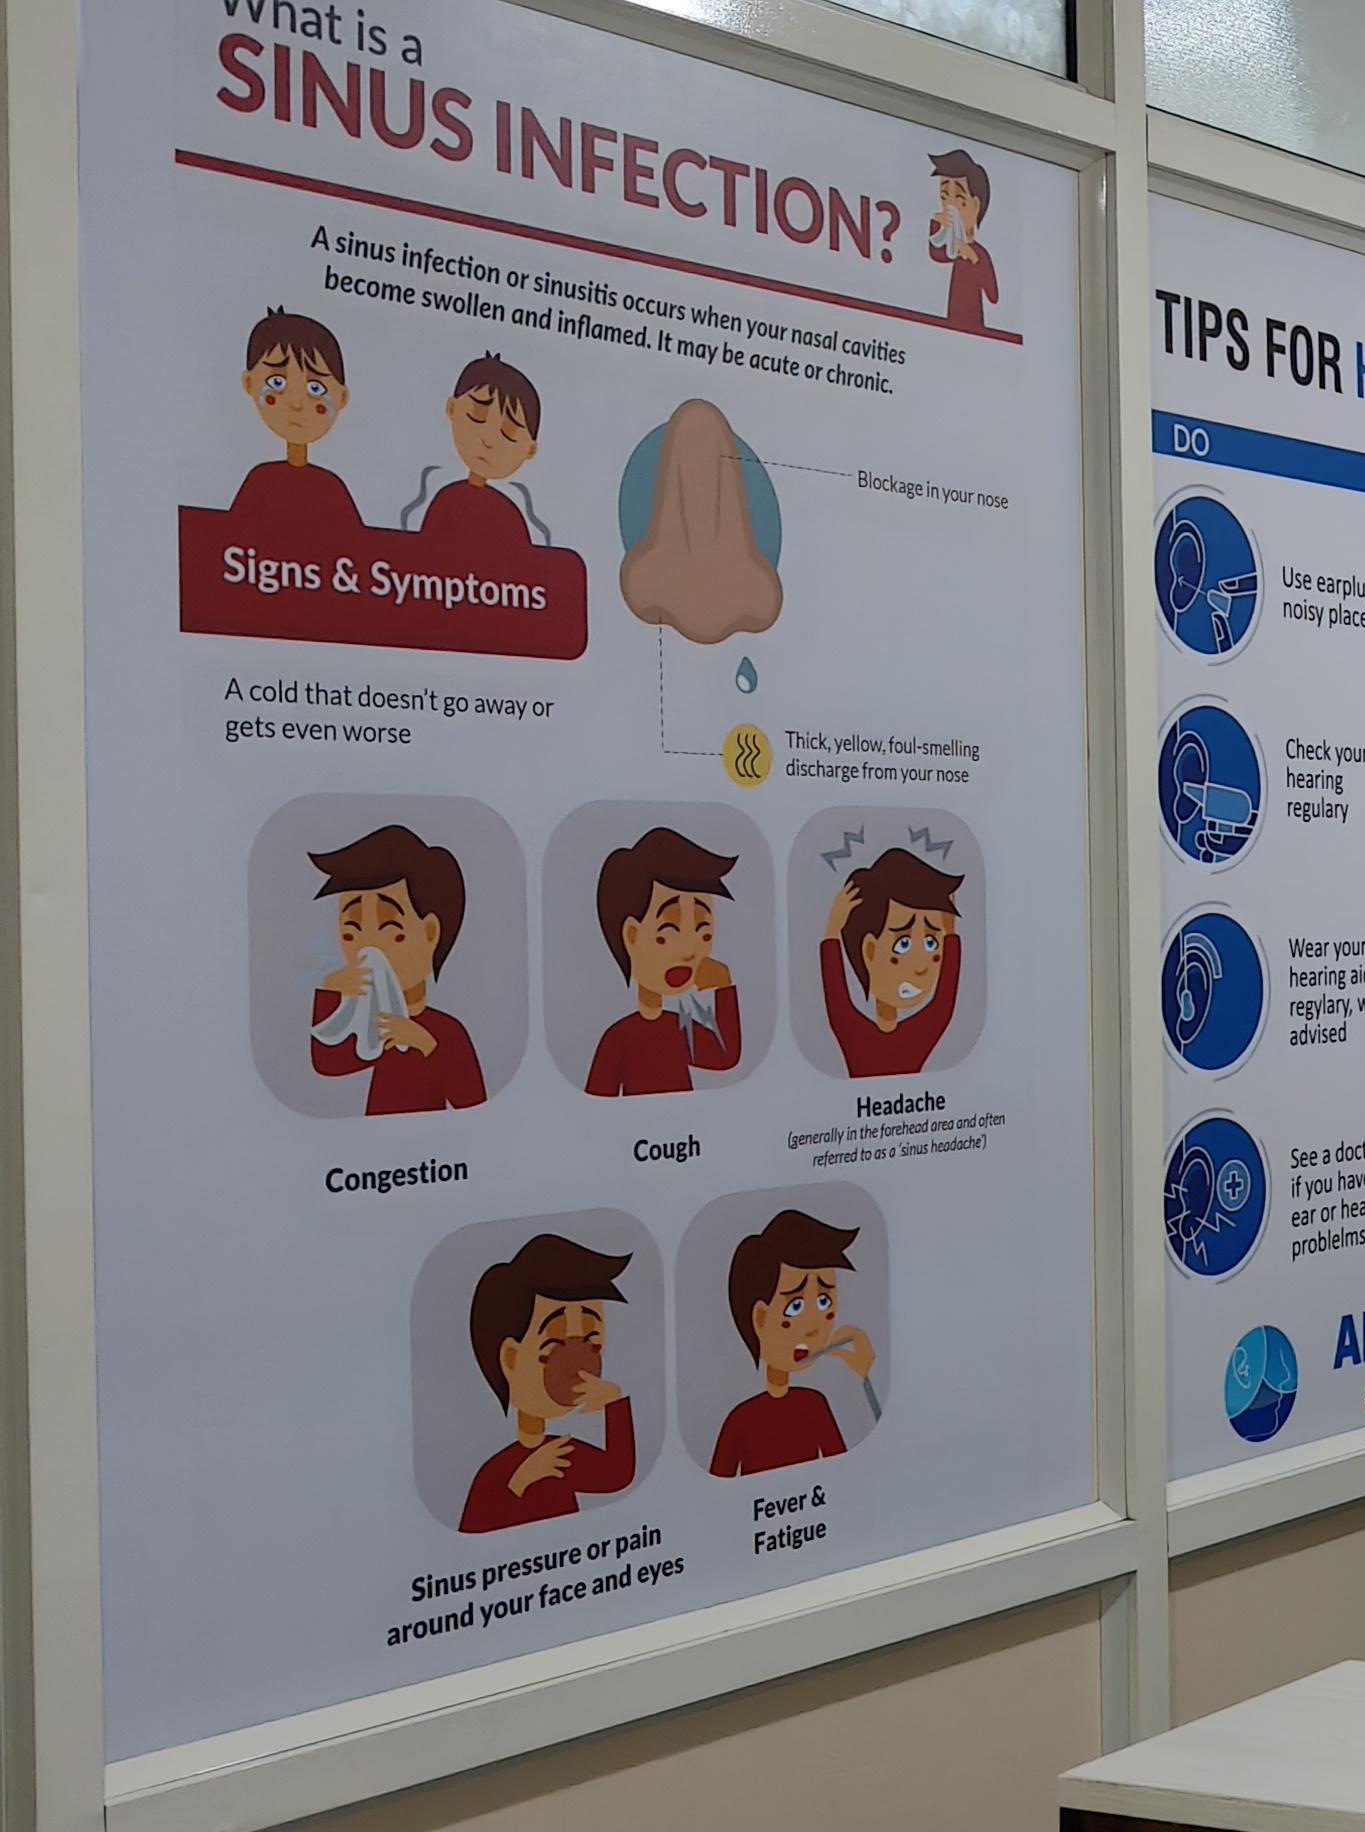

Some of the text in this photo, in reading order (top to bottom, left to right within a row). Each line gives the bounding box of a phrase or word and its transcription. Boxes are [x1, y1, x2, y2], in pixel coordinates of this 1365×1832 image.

[356, 8, 388, 56] is
[401, 34, 423, 67] a
[215, 32, 902, 264] SINUS INFECTION?
[310, 225, 906, 365] A sinus infection or sinusitis occurs when your nasal cavities
[324, 264, 893, 395] become swollen and inflamed. It may be acute or chronic.
[1155, 288, 1250, 372] TIPS
[1265, 317, 1344, 395] FOR
[1173, 423, 1210, 457] DO
[857, 469, 1009, 510] Blockage in your nose
[223, 545, 547, 610] Signs & Symptoms
[1282, 565, 1312, 591] Use
[1283, 598, 1325, 628] noisy
[224, 677, 244, 702] A
[249, 679, 298, 704] cold
[304, 681, 353, 707] that
[443, 696, 469, 718] go
[474, 697, 528, 721] away
[532, 700, 555, 718] or
[225, 716, 411, 745] gets even worse
[784, 730, 980, 762] Thick, yellow, foul-smelling
[1285, 737, 1332, 761] Check
[785, 757, 970, 785] discharge from your nose
[1286, 765, 1344, 796] hearing
[1287, 796, 1349, 824] regulary
[1288, 937, 1330, 959] Wear
[1289, 965, 1347, 991] hearing
[1289, 992, 1353, 1021] regylary,
[1289, 1020, 1347, 1047] advised
[856, 1090, 946, 1119] Headache
[787, 1112, 1006, 1150] (generally in the forehead area and often
[633, 1133, 701, 1163] Cough
[812, 1147, 858, 1168] referred
[860, 1147, 873, 1162] to
[873, 1148, 887, 1161] as
[888, 1146, 896, 1159] a
[1290, 1147, 1318, 1170] See
[1322, 1148, 1331, 1165] a
[325, 1158, 468, 1194] Congestion
[1291, 1174, 1302, 1199] if
[1304, 1177, 1333, 1202] you
[1291, 1208, 1317, 1228] ear
[1320, 1205, 1337, 1223] or
[753, 1484, 827, 1522] Fever &
[754, 1522, 827, 1555] Fatigue
[411, 1524, 662, 1602] Sinus pressure or pain
[387, 1557, 685, 1647] around your face and eyes
